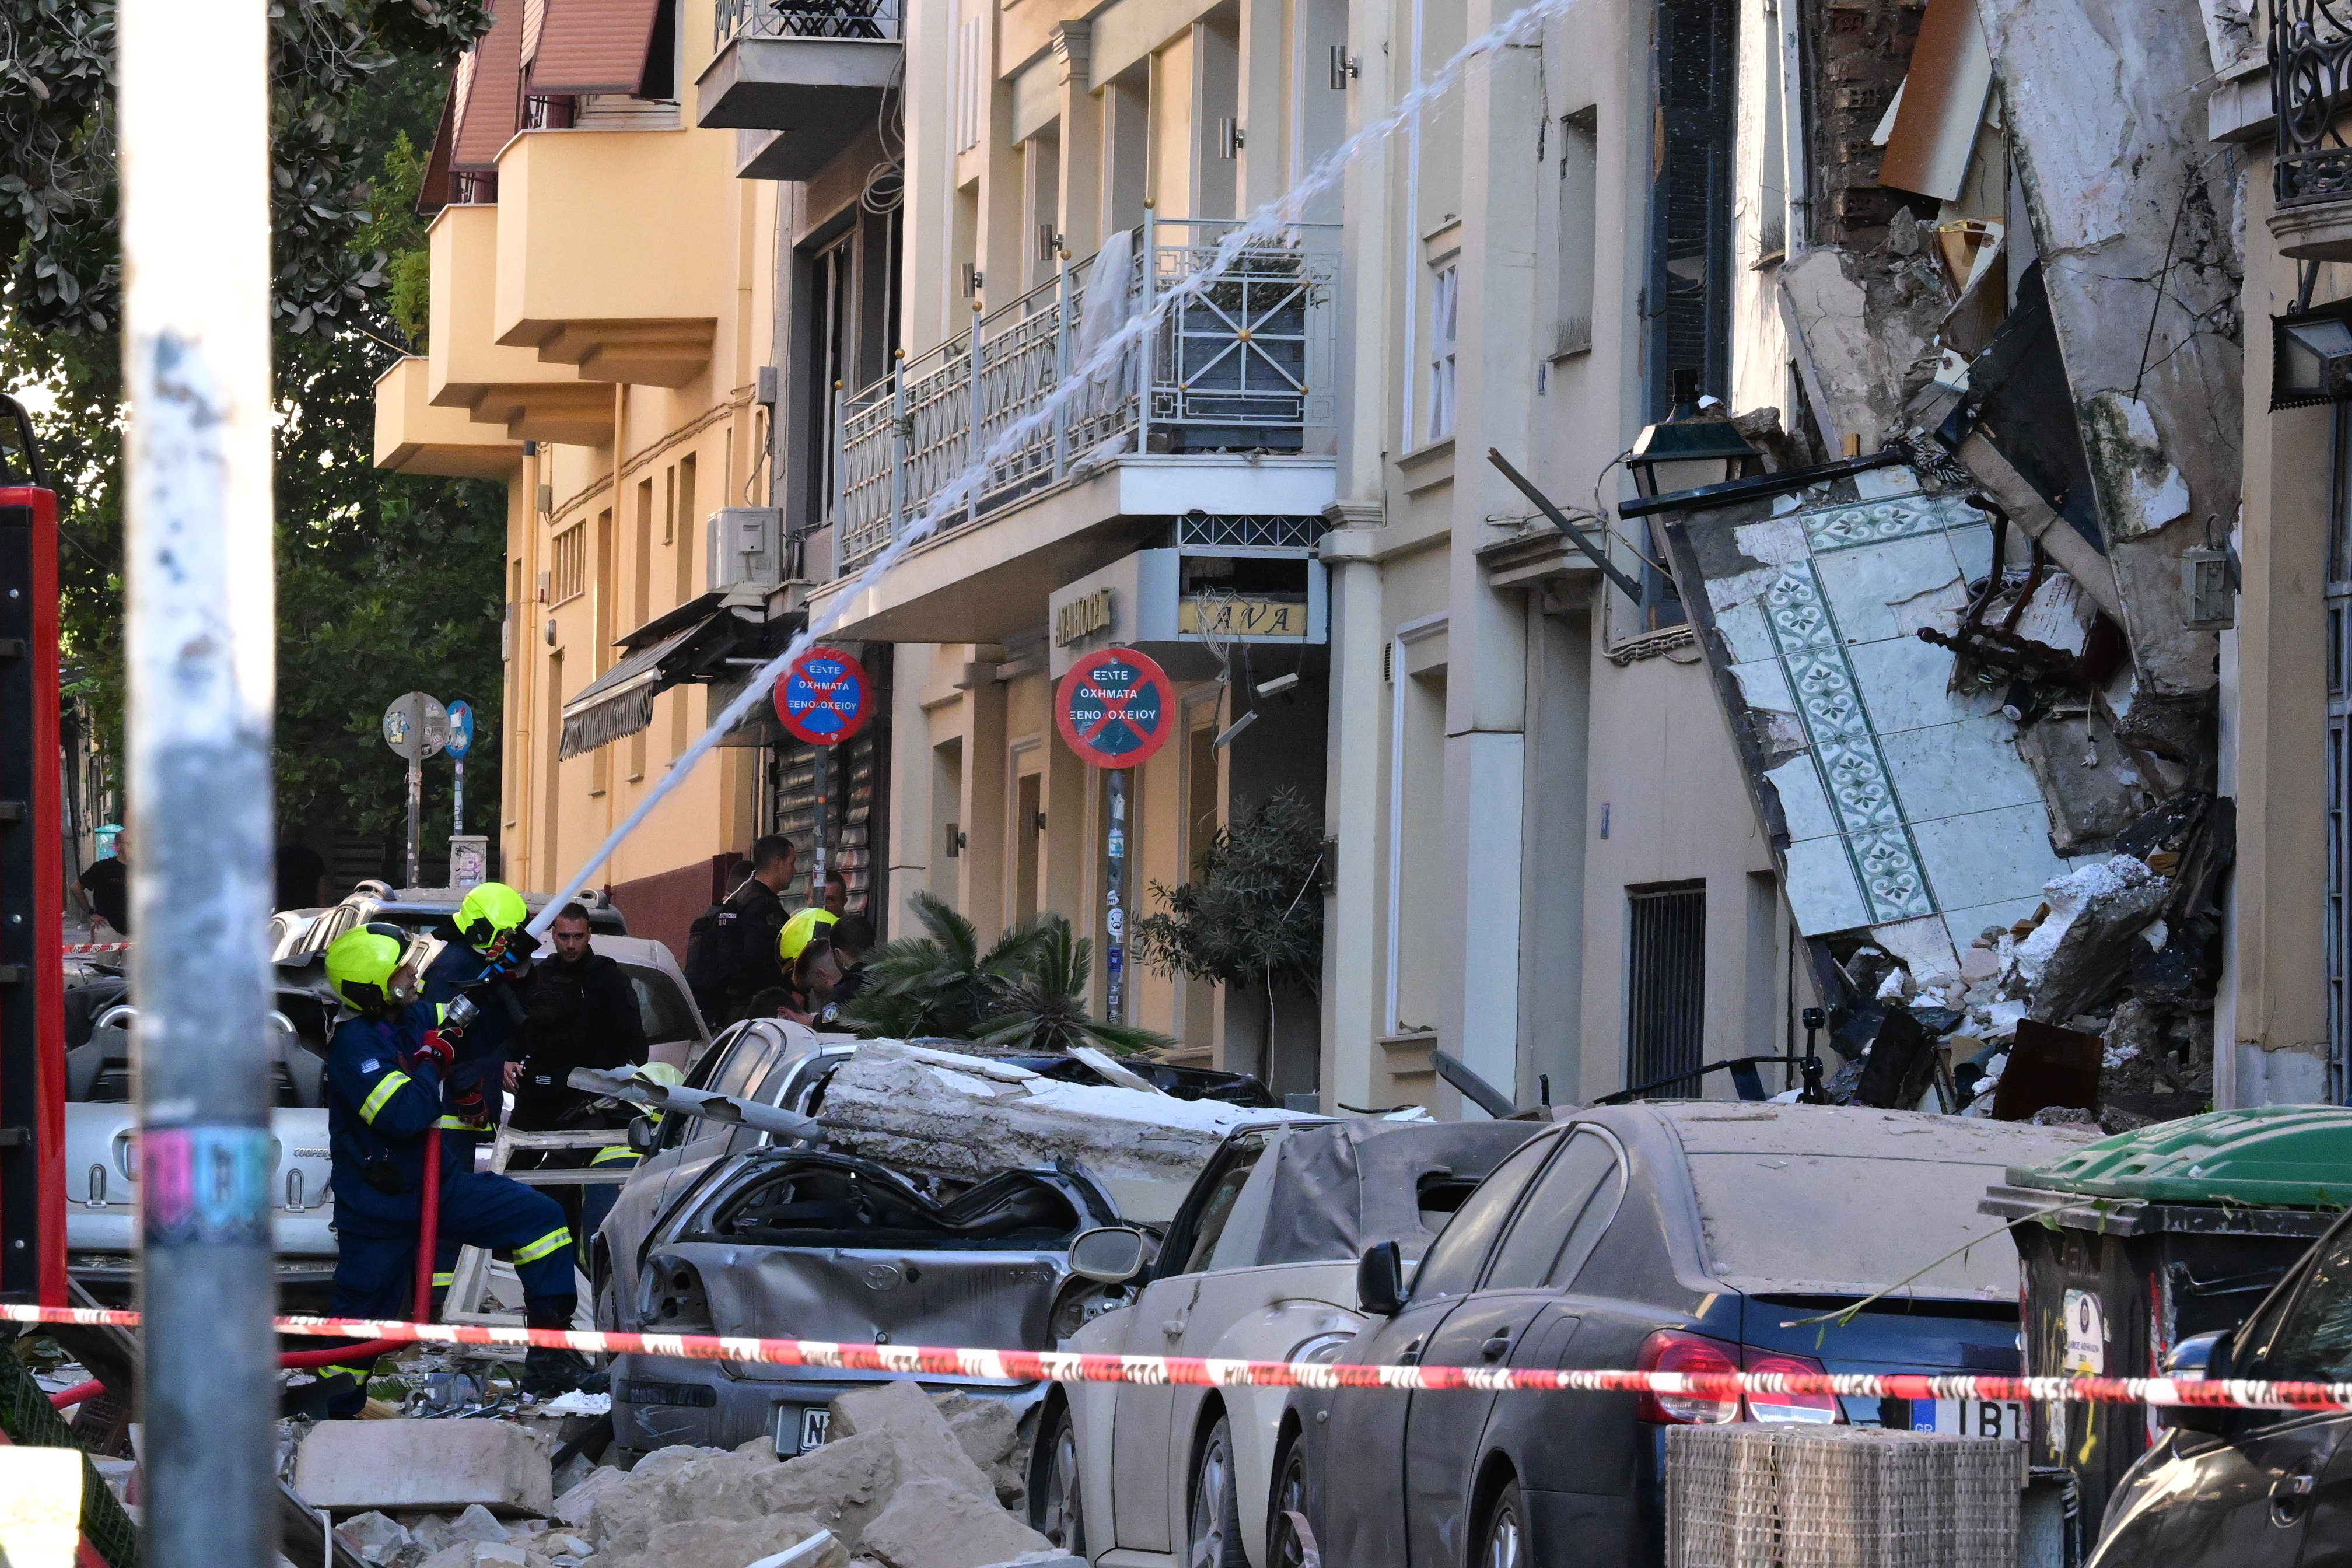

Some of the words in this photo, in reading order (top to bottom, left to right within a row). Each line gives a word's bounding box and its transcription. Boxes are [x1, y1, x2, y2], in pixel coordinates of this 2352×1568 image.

[1207, 603, 1289, 633] AVA
[799, 680, 849, 690] ΟΧΗΜΑΤΑ
[1080, 688, 1138, 698] ΟΧΗΜΑΤΑ
[1069, 709, 1156, 720] ΞΕΝΟΟΧΕΙΟΥ
[293, 1147, 328, 1158] COOPER
[807, 1414, 830, 1444] N
